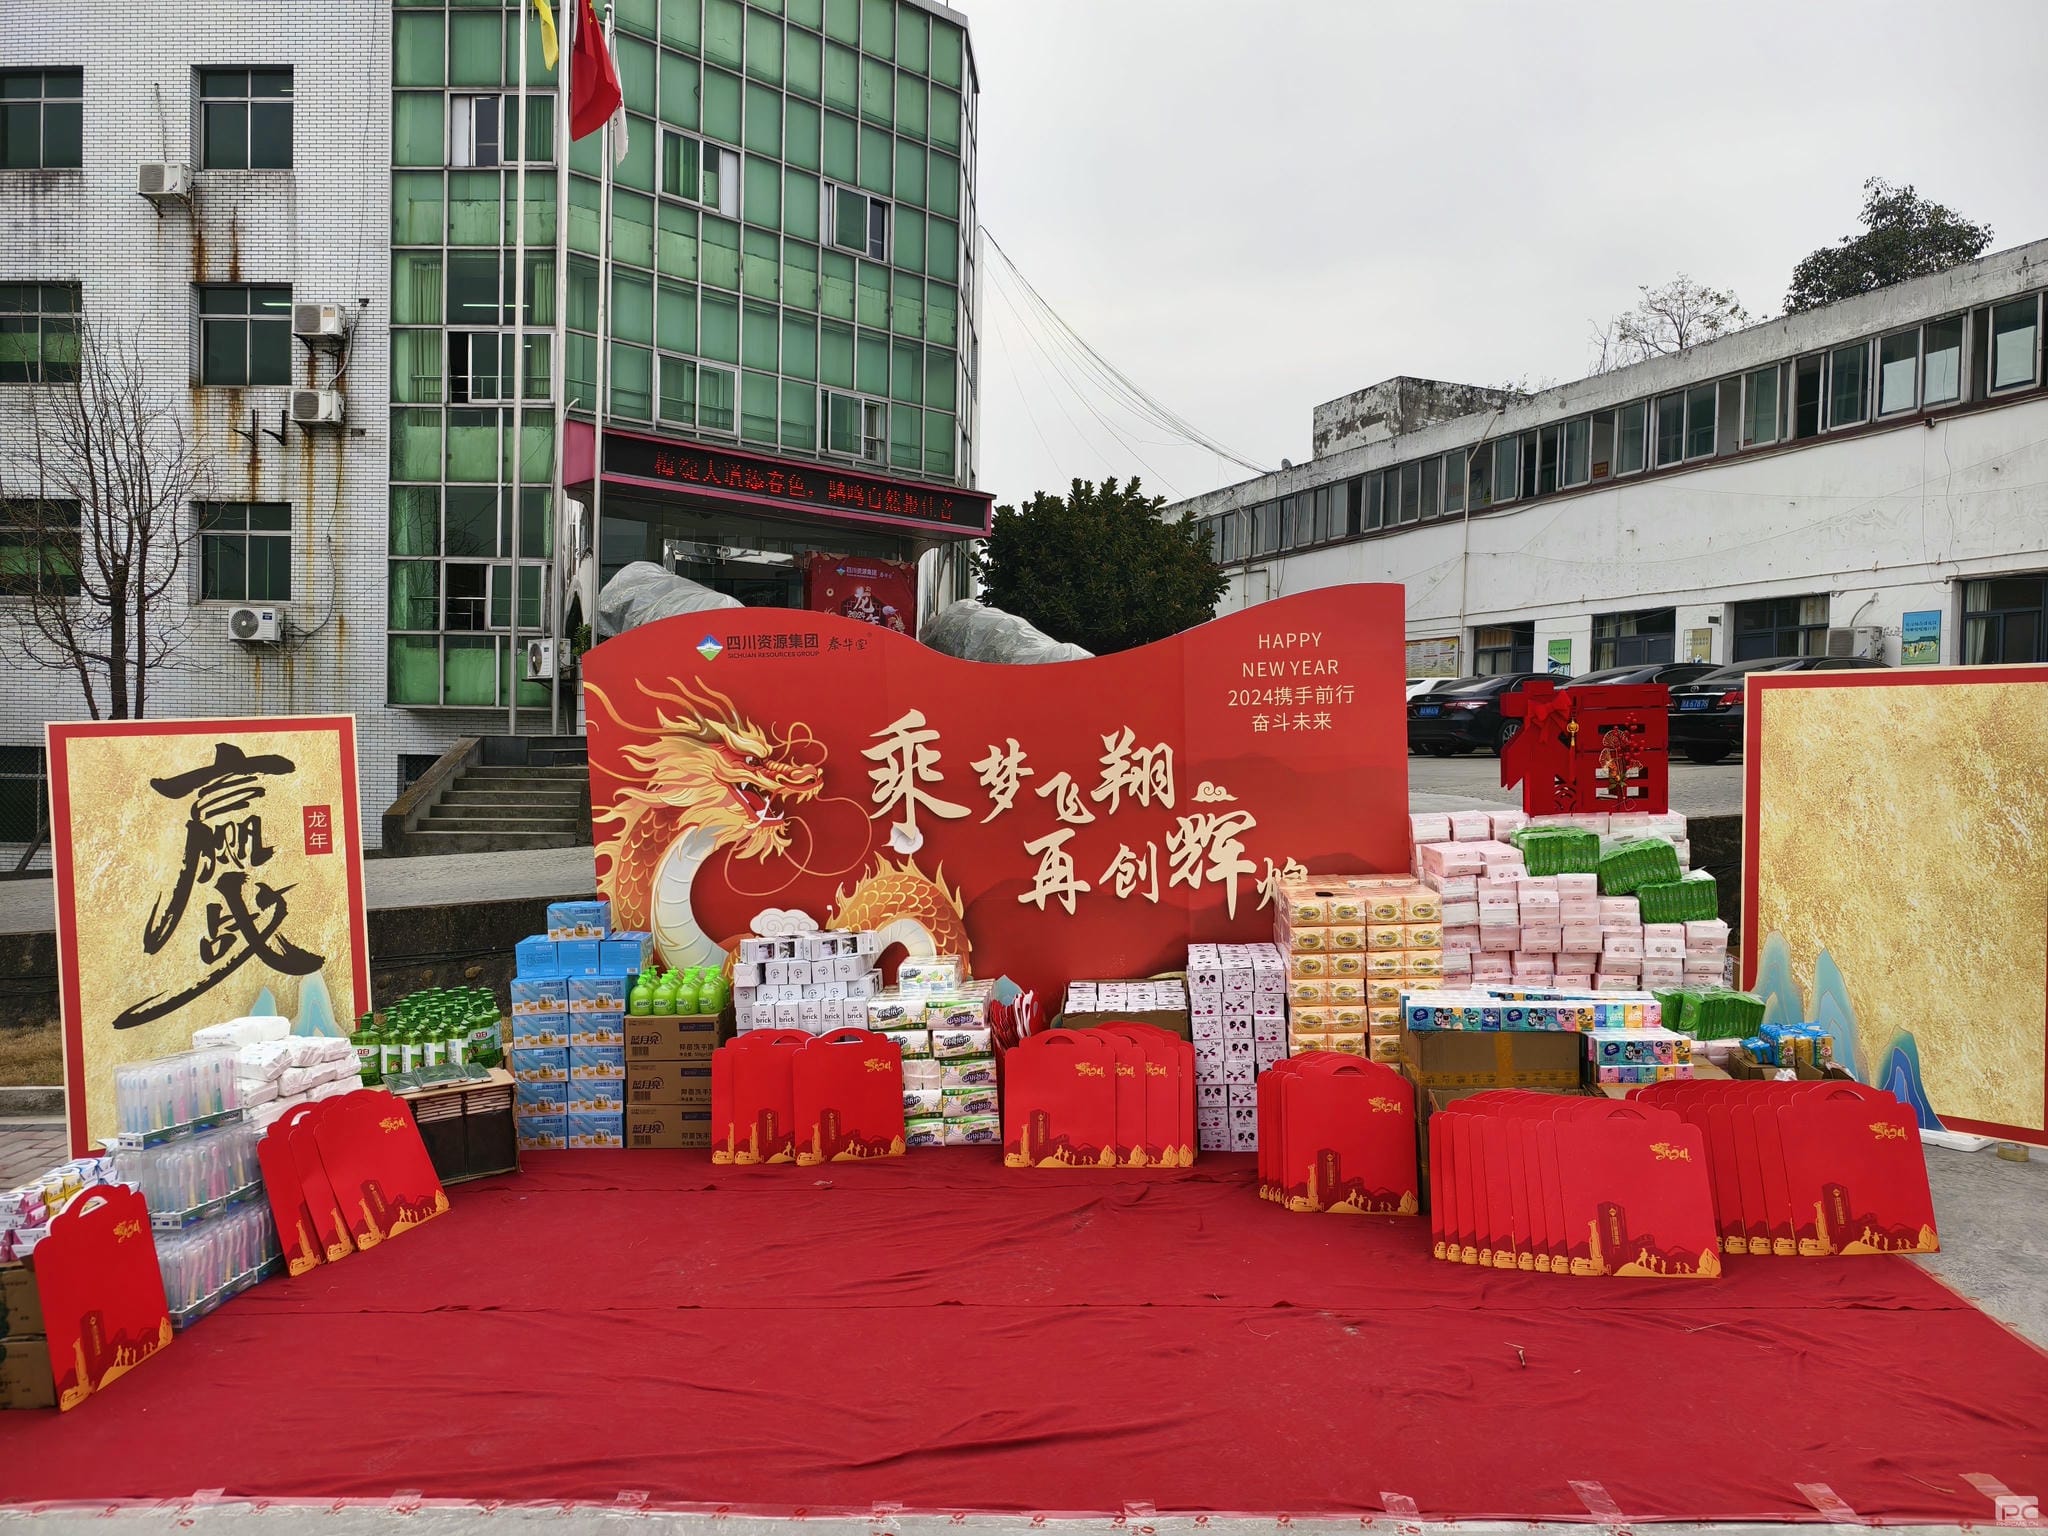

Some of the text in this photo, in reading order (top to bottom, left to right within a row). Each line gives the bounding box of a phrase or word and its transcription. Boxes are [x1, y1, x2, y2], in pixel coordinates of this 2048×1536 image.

[727, 633, 819, 651] 四川资源集团
[1258, 632, 1322, 649] HAPPY
[796, 650, 820, 658] GROUP
[1242, 659, 1339, 678] NEW YEAR
[1228, 684, 1355, 707] 2024携手前行
[1251, 711, 1332, 733] 奋斗未来
[861, 709, 1176, 841] 乘梦飞翔
[308, 811, 329, 849] 龙年
[630, 1033, 661, 1045] 蓝月亮
[632, 1077, 664, 1090] 蓝月亮
[632, 1121, 664, 1134] 蓝月亮
